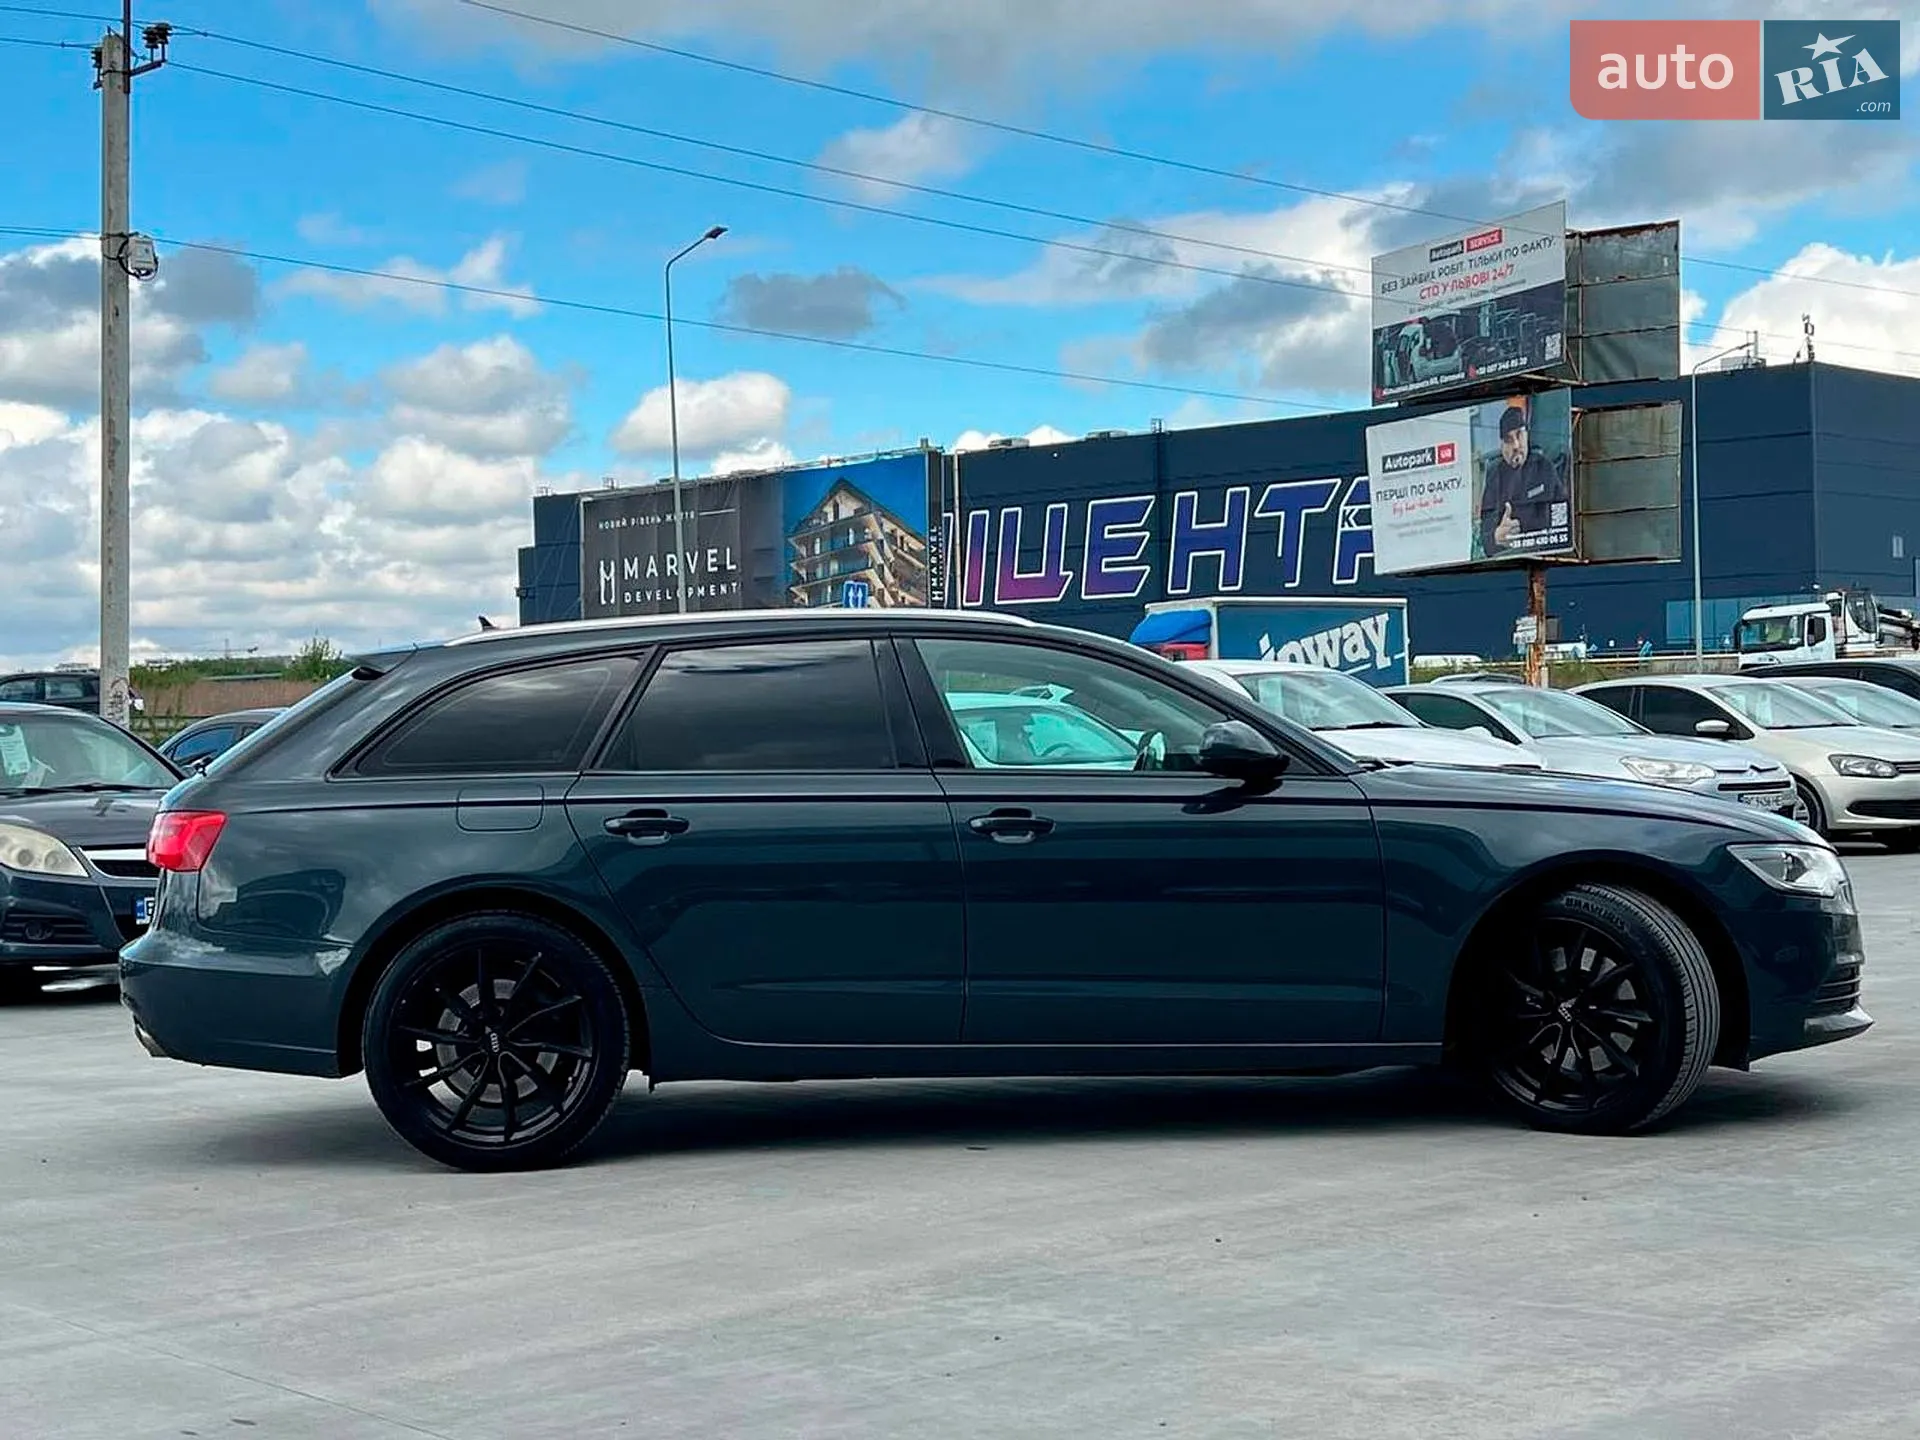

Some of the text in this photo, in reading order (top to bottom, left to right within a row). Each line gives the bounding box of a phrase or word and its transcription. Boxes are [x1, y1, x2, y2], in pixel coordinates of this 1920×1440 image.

[1381, 280, 1398, 294] БЕЗ
[1400, 271, 1436, 289] ЗАЙВИХ
[1468, 253, 1502, 271] ТІЛЬКИ
[1503, 245, 1519, 261] ПО
[1419, 283, 1440, 300] СТО
[1449, 271, 1490, 291] ЛЬВОВІ
[1491, 263, 1516, 282] 24/7
[1384, 448, 1433, 470] Autopark
[1376, 486, 1409, 502] ПЕРШІ
[1410, 484, 1425, 497] ПО
[599, 517, 627, 529] НОВИЙ
[624, 547, 737, 581] MARVEL
